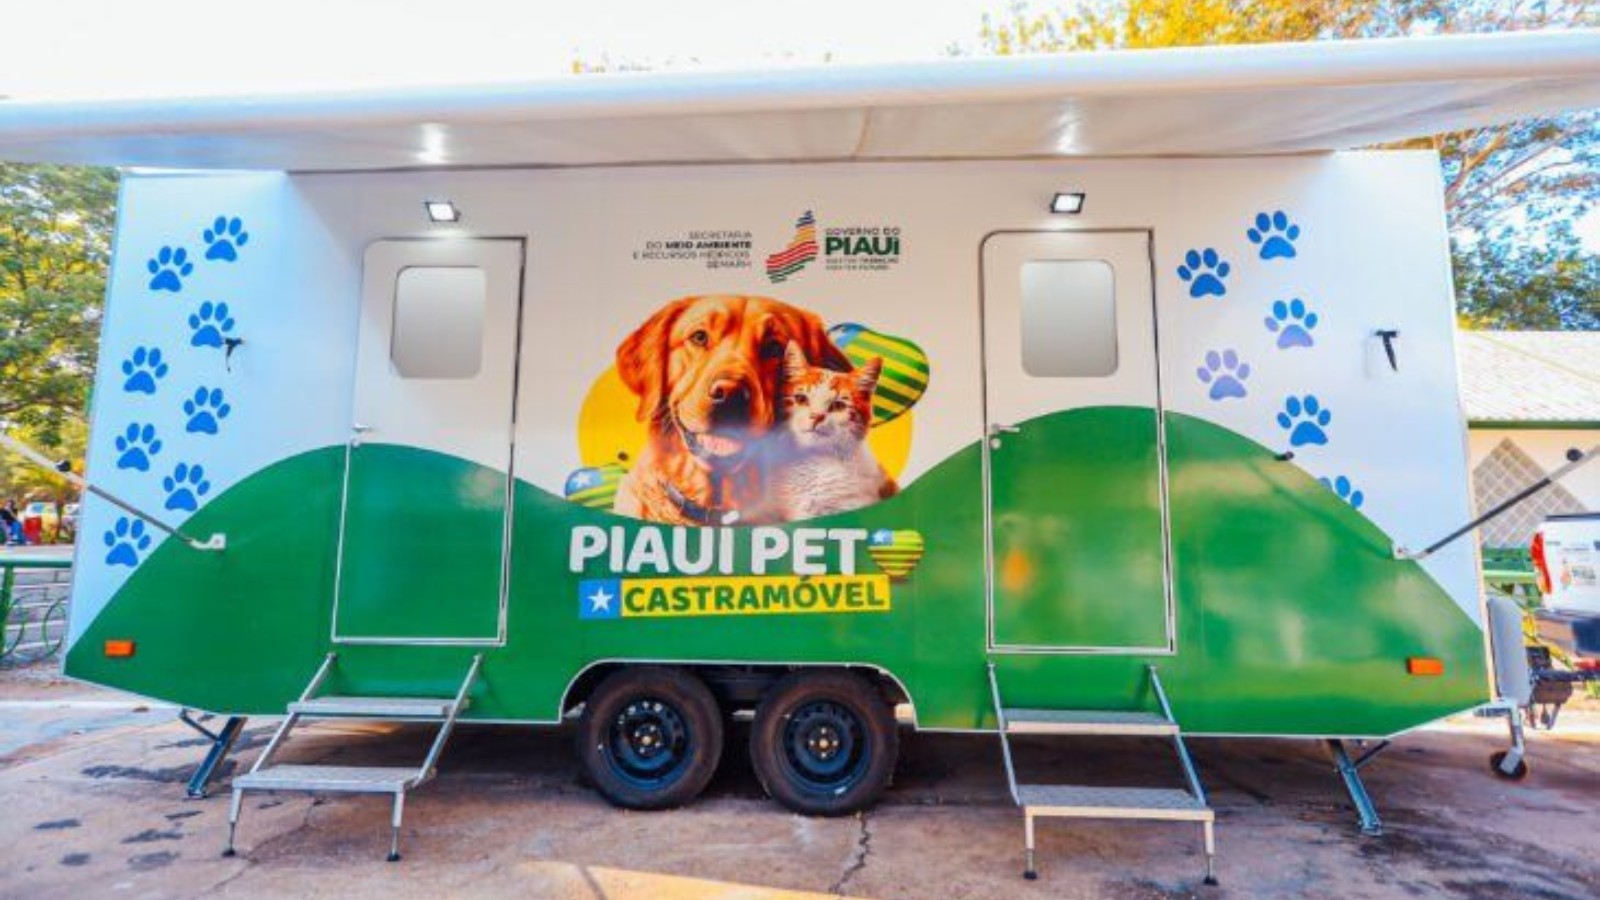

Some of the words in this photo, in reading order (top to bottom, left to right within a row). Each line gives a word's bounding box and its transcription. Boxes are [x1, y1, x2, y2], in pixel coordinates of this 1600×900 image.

[646, 241, 662, 249] DO
[665, 241, 693, 249] MEIO
[696, 241, 752, 249] AMBIENTE
[568, 511, 740, 575] PIAUÍ
[750, 527, 868, 575] PET
[623, 575, 885, 614] CASTRAMÓVEL
